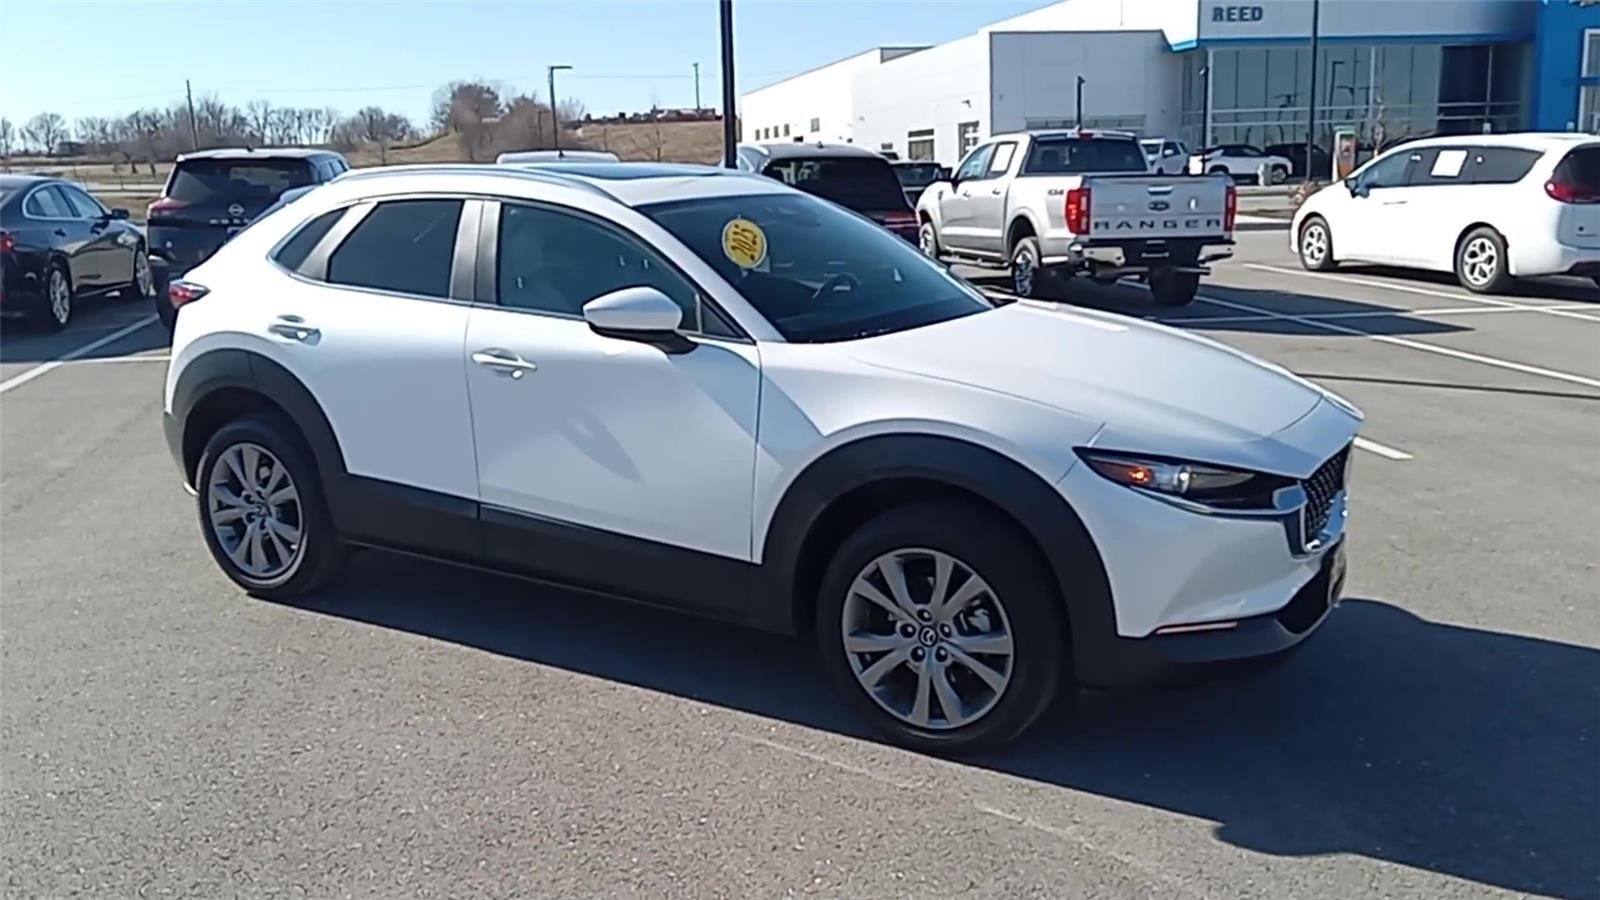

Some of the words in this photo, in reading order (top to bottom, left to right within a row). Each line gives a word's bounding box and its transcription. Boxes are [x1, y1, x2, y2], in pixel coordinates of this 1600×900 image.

[1211, 6, 1263, 22] REED
[1093, 218, 1221, 230] RANGER
[731, 223, 757, 261] 2025
